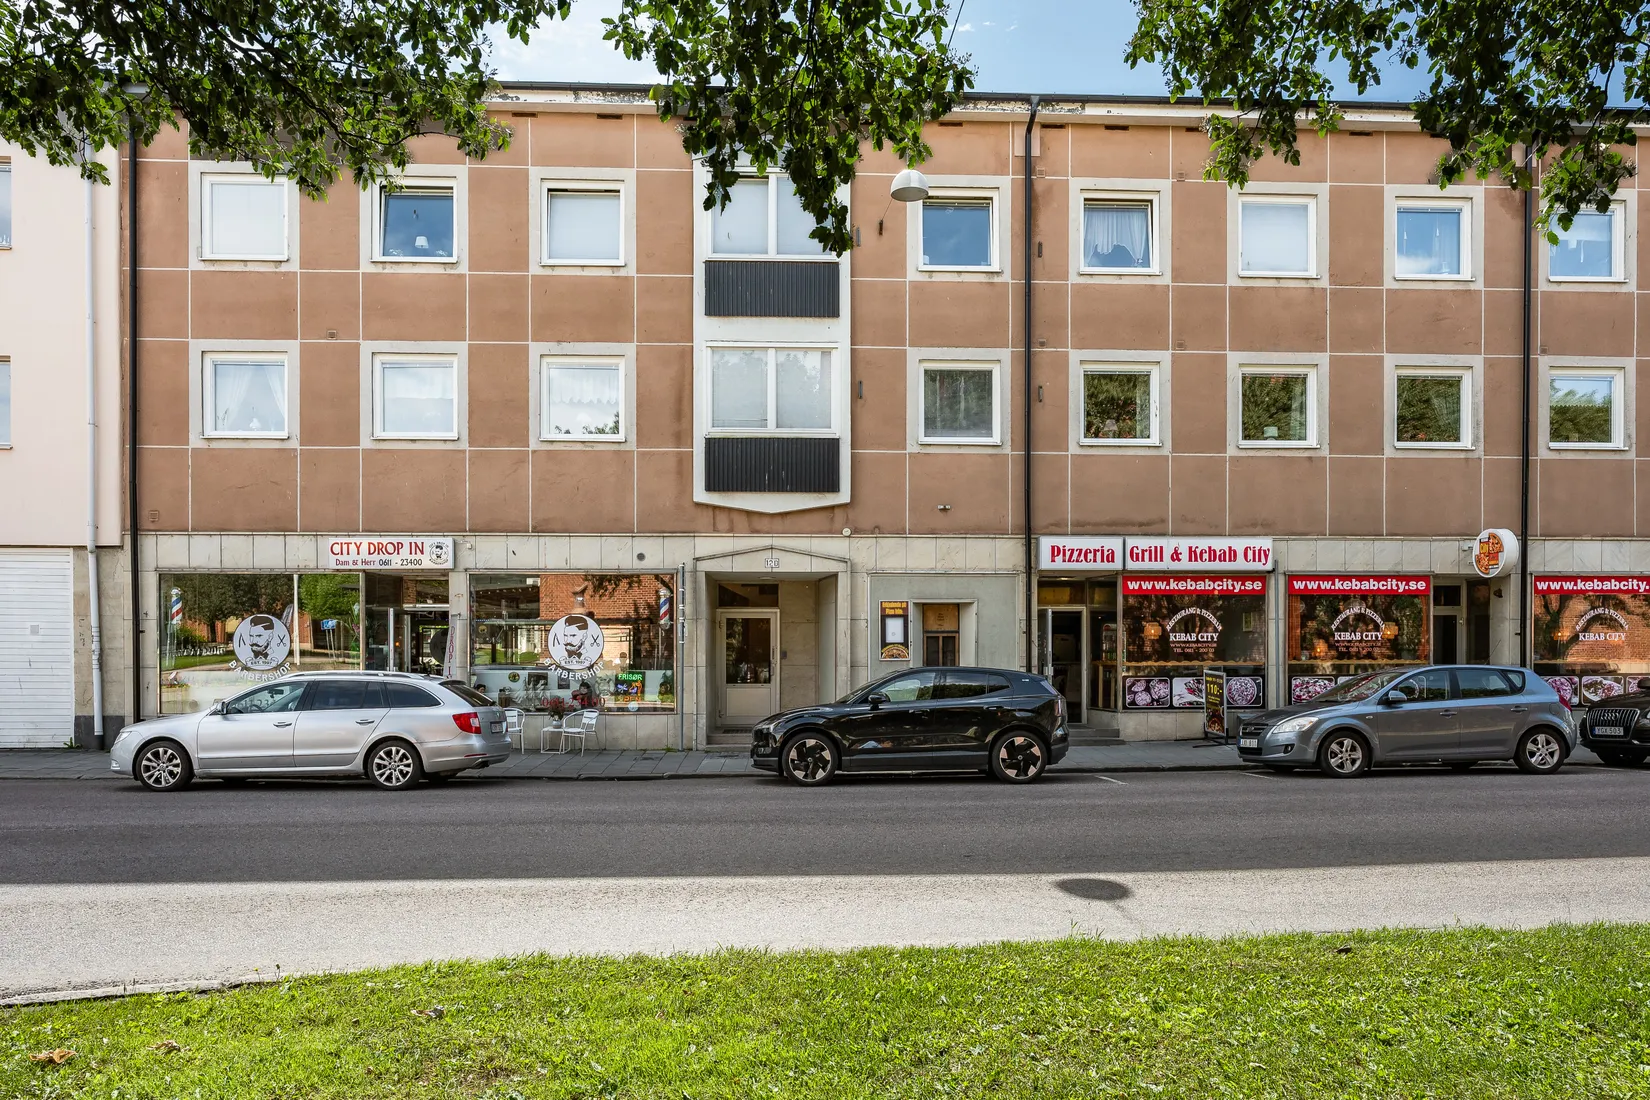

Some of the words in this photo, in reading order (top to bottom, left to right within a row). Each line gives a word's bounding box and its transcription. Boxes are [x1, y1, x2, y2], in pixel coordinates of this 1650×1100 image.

[330, 541, 362, 556] CITY
[367, 541, 404, 556] DROP
[409, 541, 425, 556] IN
[1050, 545, 1116, 563] Pizzeria
[1129, 546, 1164, 563] Grill
[1170, 546, 1182, 563] &
[1187, 545, 1238, 563] Kebab
[1243, 545, 1271, 566] City
[335, 558, 350, 566] Dam
[361, 558, 376, 566] Herr
[378, 558, 392, 567] 0611
[400, 558, 423, 566] 23400
[1127, 579, 1263, 592] www.kebabcity.se
[1293, 578, 1427, 592] www.kebabcity.se
[1169, 632, 1197, 641] KEBAB
[1198, 632, 1219, 641] CITY
[1334, 632, 1361, 640] KEBAB
[1362, 632, 1383, 640] CITY
[1579, 632, 1605, 640] KEBAB
[1606, 632, 1626, 640] CITY
[228, 660, 291, 682] BARBERSHOP
[543, 658, 605, 680] BARBERSHOP
